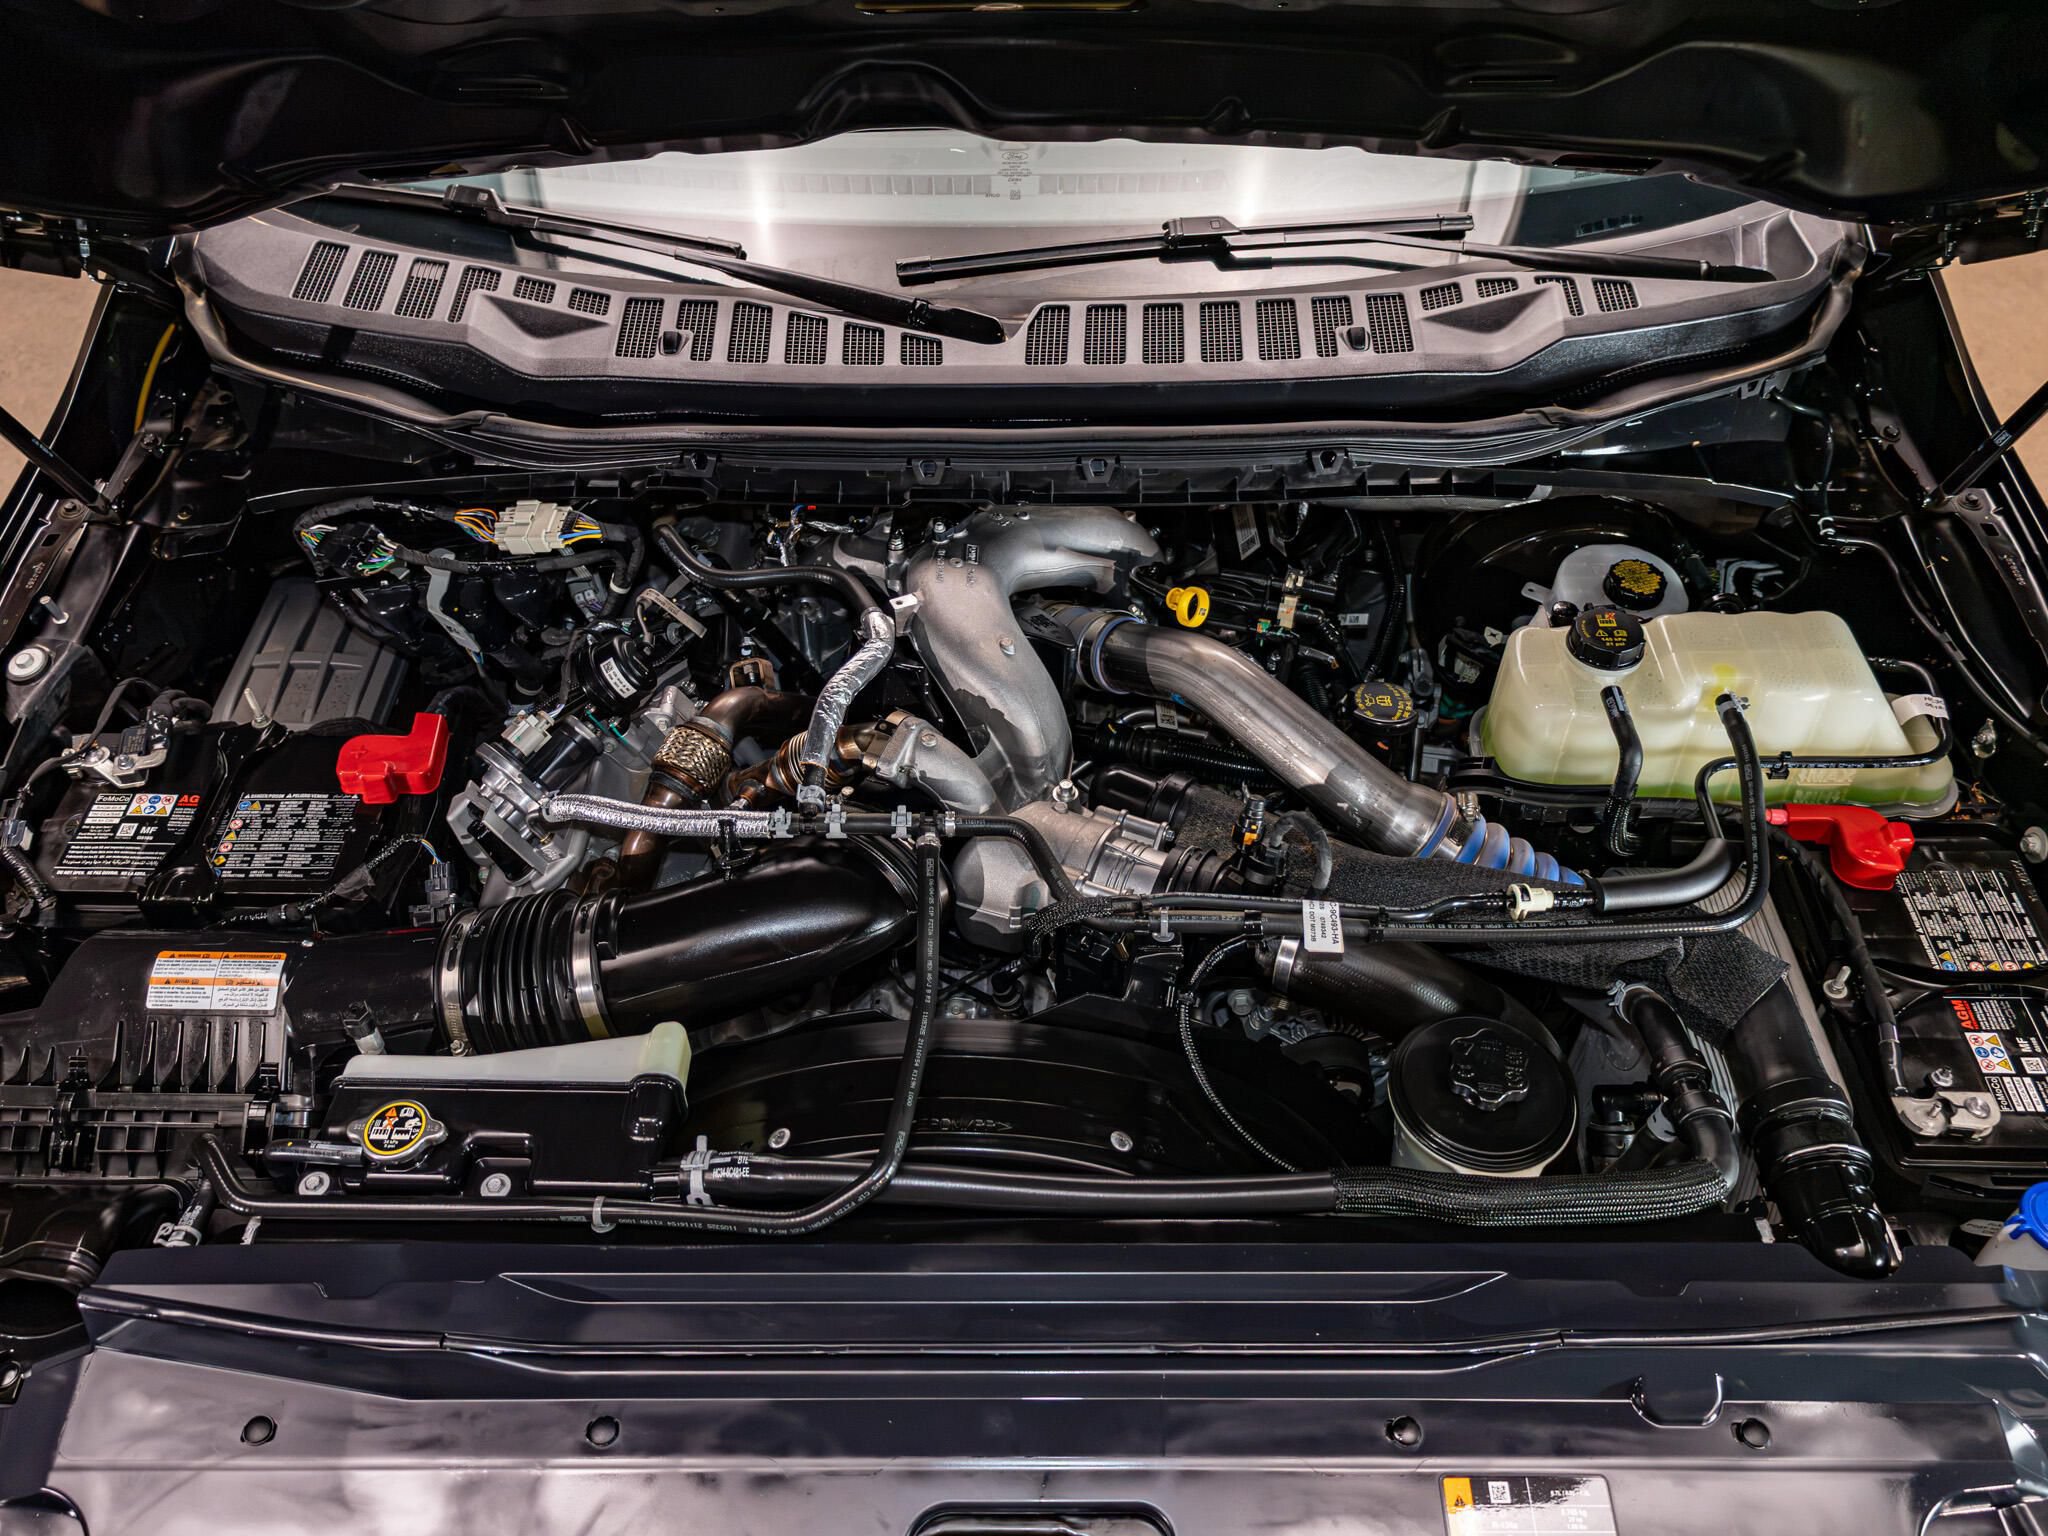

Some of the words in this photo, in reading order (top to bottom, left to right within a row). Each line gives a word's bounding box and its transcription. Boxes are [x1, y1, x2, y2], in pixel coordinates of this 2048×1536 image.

[97, 795, 130, 803] FoMoCo
[140, 826, 158, 834] MF
[1951, 1000, 1974, 1030] AGM
[2015, 1037, 2032, 1053] MF
[1991, 1077, 2007, 1111] FoMoCo
